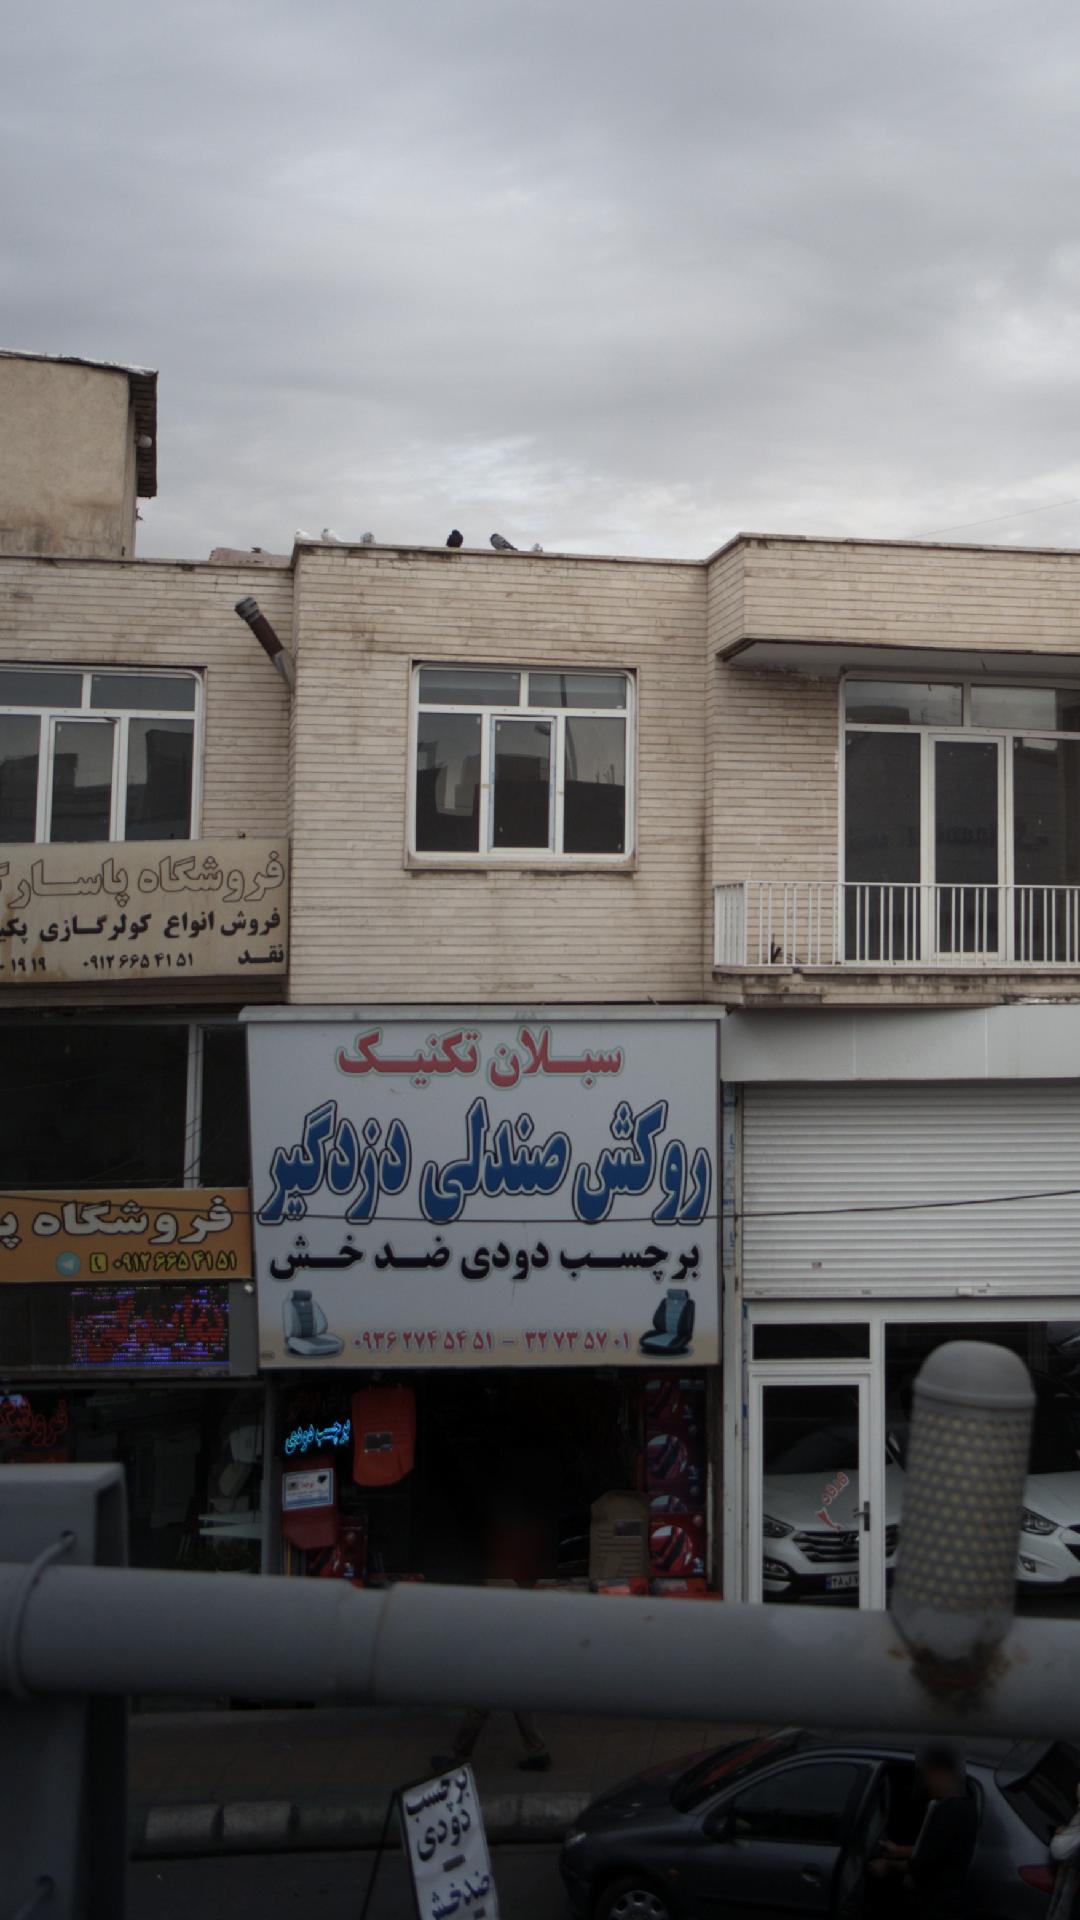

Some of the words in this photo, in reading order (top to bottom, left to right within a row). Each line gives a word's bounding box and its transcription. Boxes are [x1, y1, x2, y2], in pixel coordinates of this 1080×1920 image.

[138, 850, 285, 902] فروشگاه
[164, 910, 214, 938] انواع
[220, 907, 280, 936] فروش
[238, 943, 284, 964] نقد
[338, 1031, 478, 1085] تکنیک
[489, 1028, 622, 1087] سبلان
[257, 1099, 412, 1225] دزدگیر
[419, 1096, 572, 1225] صندلی
[572, 1099, 712, 1225] روکش
[32, 1195, 233, 1244] فروشگاه
[269, 1236, 363, 1280] خش
[374, 1236, 451, 1269] ضد
[460, 1242, 549, 1280] دودی
[560, 1242, 701, 1280] برچسب
[405, 1769, 470, 1823] برچسب
[417, 1810, 471, 1862] دودی
